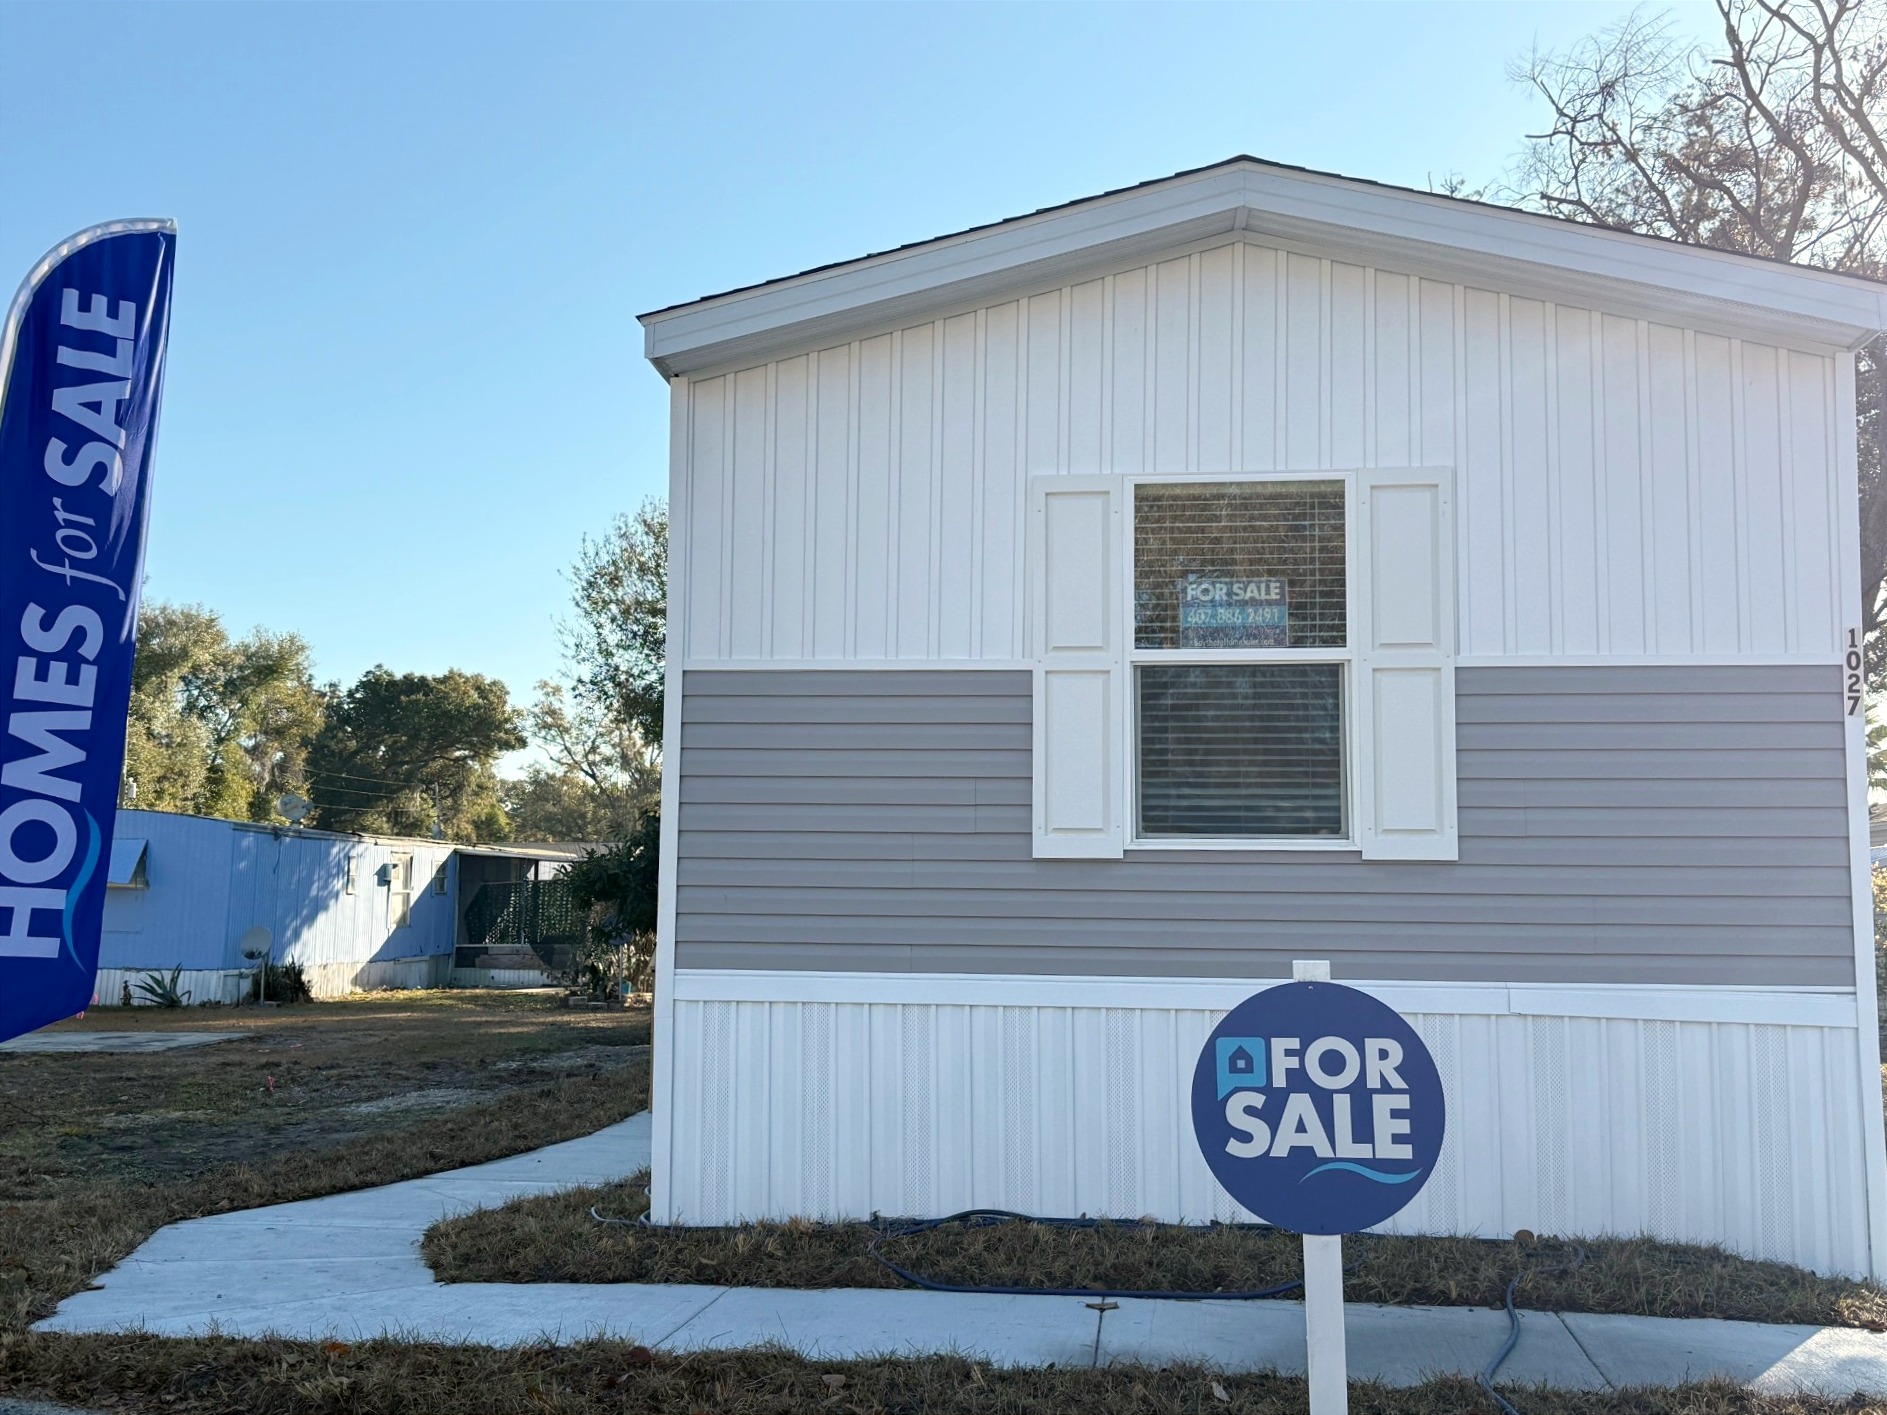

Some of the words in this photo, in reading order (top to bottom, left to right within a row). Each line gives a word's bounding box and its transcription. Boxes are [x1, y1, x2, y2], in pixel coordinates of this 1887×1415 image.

[44, 288, 136, 497] SALE
[30, 496, 126, 601] for
[1187, 583, 1228, 601] FOR
[1232, 582, 1281, 600] SALE
[1846, 628, 1861, 716] 1027
[0, 602, 104, 959] HOMES
[1270, 1036, 1409, 1090] FOR
[1224, 1090, 1413, 1159] SALE
